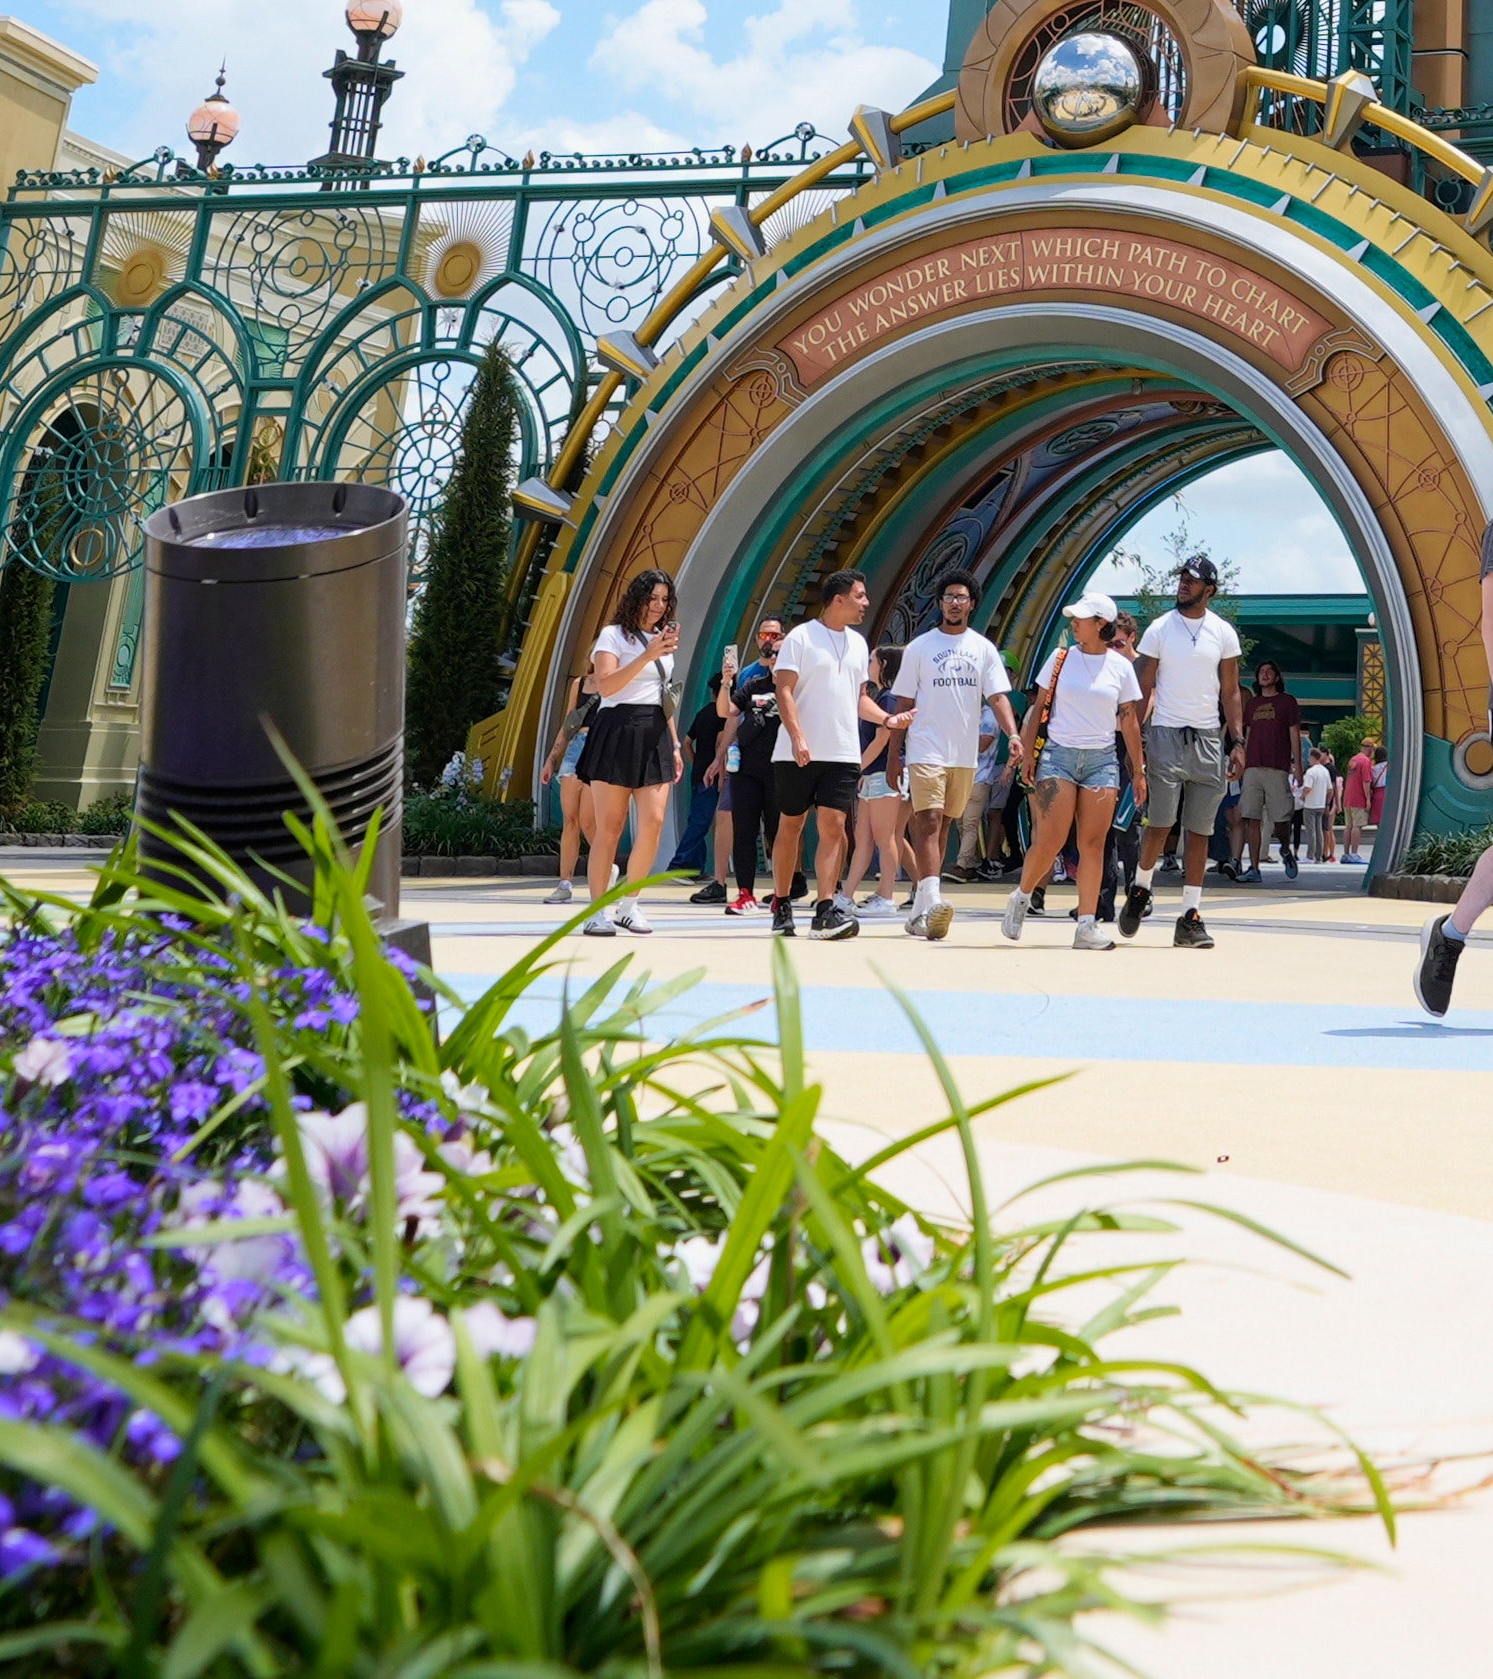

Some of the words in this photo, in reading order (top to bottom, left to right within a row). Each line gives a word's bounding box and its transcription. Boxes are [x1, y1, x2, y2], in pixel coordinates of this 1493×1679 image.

[793, 310, 843, 356] YOU
[848, 258, 952, 318] WONDER
[960, 241, 1021, 271] NEXT
[1031, 236, 1119, 259] WHICH
[1128, 243, 1189, 274] PATH
[1195, 259, 1227, 288] TO
[1231, 278, 1310, 335] CHART
[821, 322, 870, 362] THE
[875, 279, 969, 334] ANSWER
[974, 267, 1021, 294] LIES
[1028, 263, 1124, 288] WITHIN
[1131, 270, 1199, 308] YOUR
[1202, 294, 1281, 349] HEART
[933, 677, 978, 687] FOOTBALL
